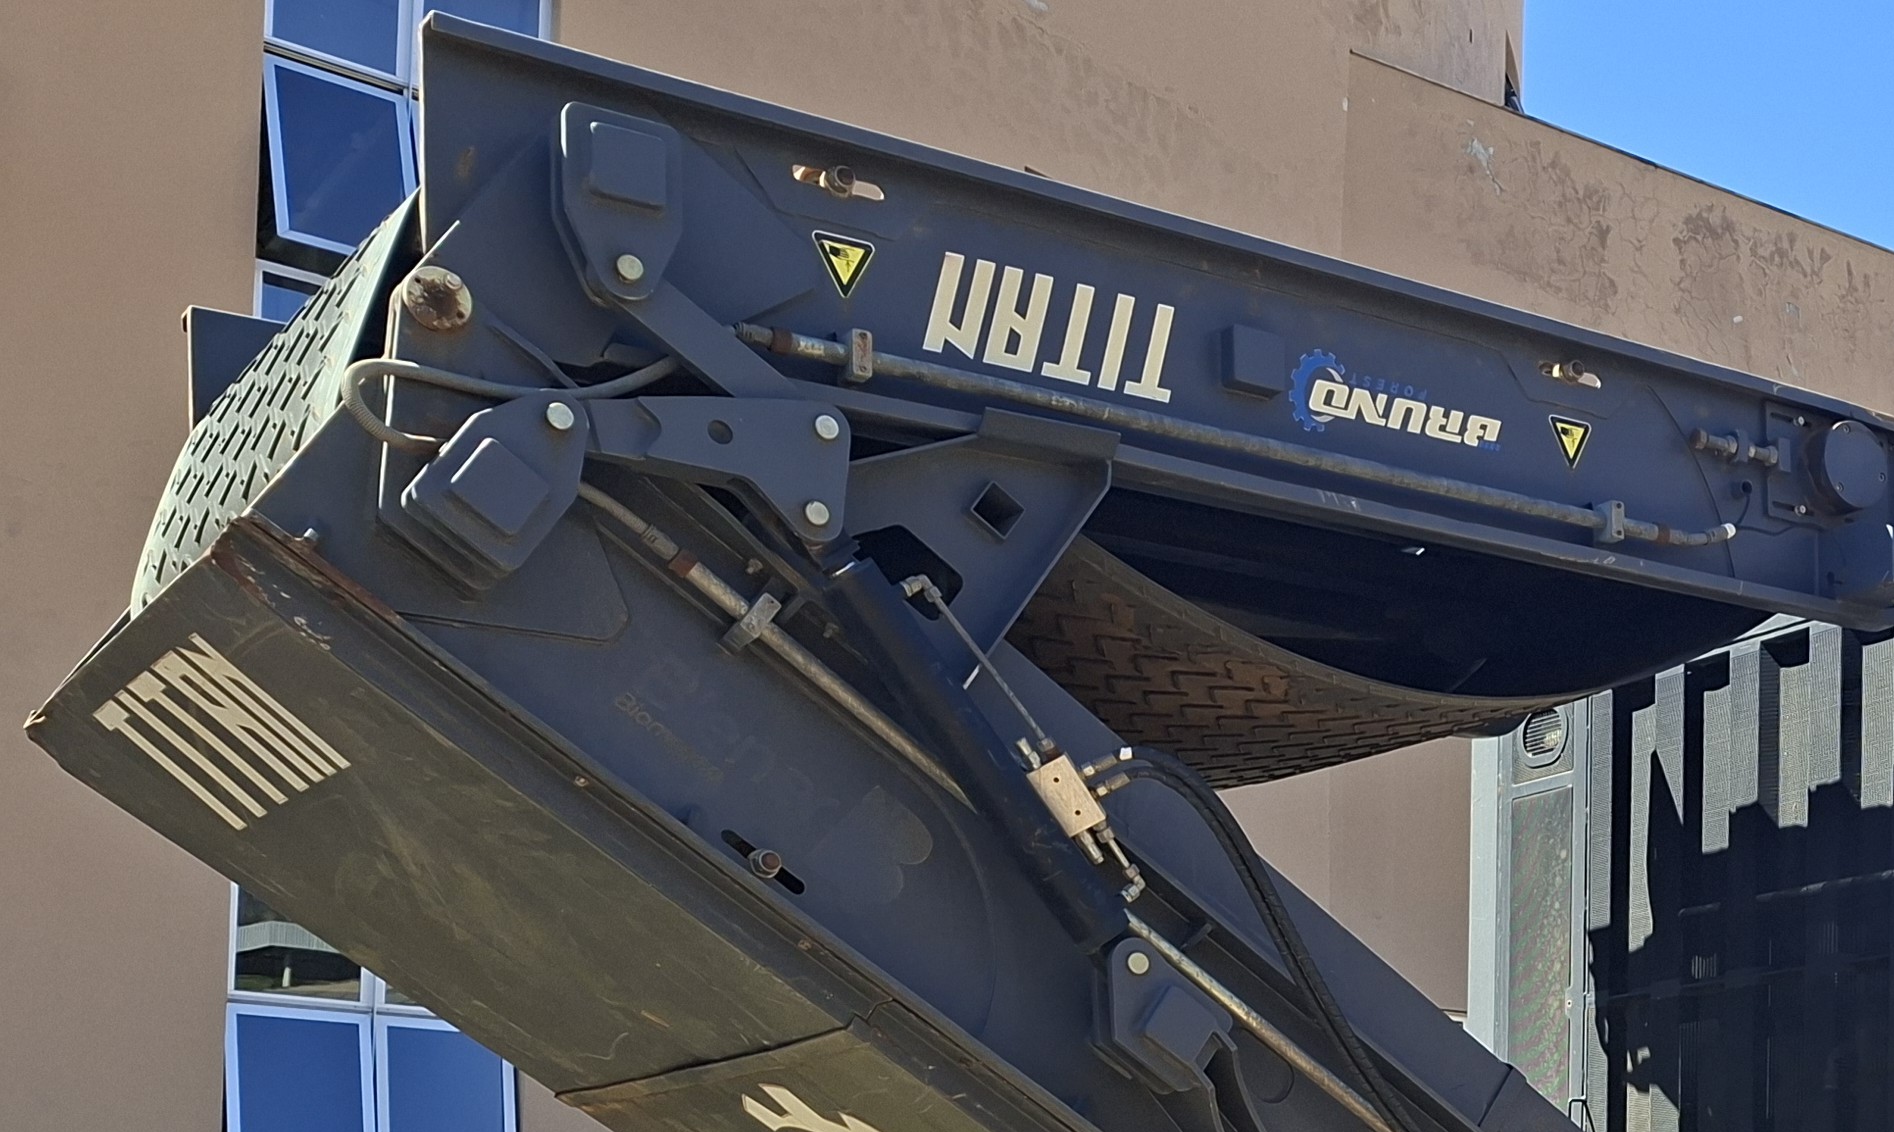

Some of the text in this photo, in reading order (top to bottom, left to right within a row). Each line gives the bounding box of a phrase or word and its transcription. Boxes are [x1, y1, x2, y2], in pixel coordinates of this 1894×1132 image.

[923, 251, 1175, 403] TITAN
[1308, 379, 1502, 447] BRUNO
[1350, 372, 1428, 400] FOREST
[93, 632, 351, 830] TITAN
